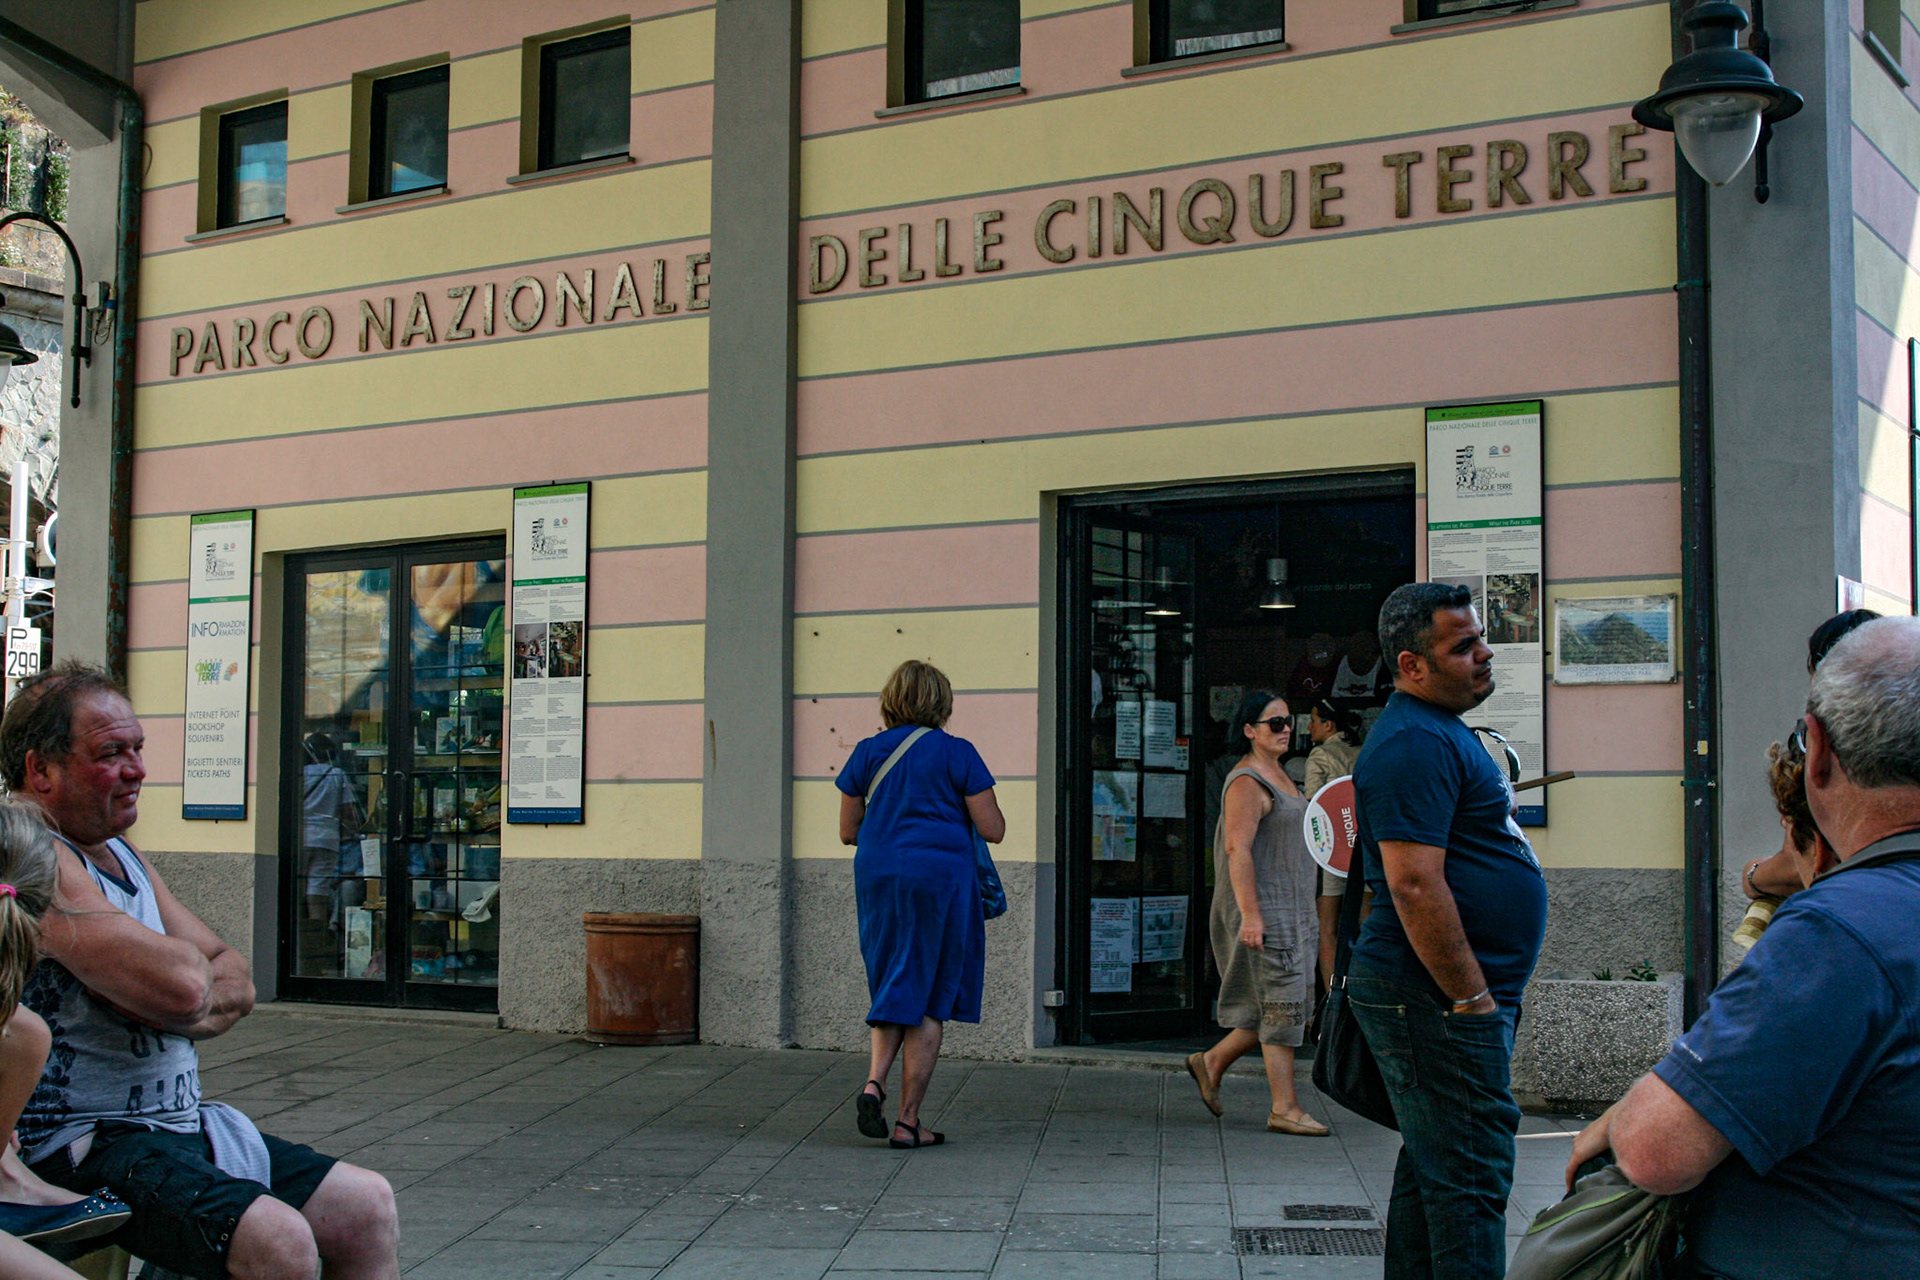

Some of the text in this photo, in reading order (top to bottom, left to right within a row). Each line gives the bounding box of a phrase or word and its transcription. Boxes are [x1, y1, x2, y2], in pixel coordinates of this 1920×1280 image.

[169, 122, 1649, 377] PARCO NAZIONALE DELLE CINQUE TERRE
[191, 621, 219, 638] INFO
[11, 627, 28, 649] P
[7, 650, 38, 677] 299
[194, 662, 222, 673] CINQUE
[197, 672, 220, 682] TERRE
[189, 710, 240, 719] INTERNET POINT
[188, 722, 225, 731] BOOKSHOP
[188, 734, 224, 743] SOUVENIRS
[187, 757, 243, 767] BIGLIETTI SENTIERI
[187, 769, 231, 778] TICKETS PATHS
[1341, 807, 1356, 848] CINQUE
